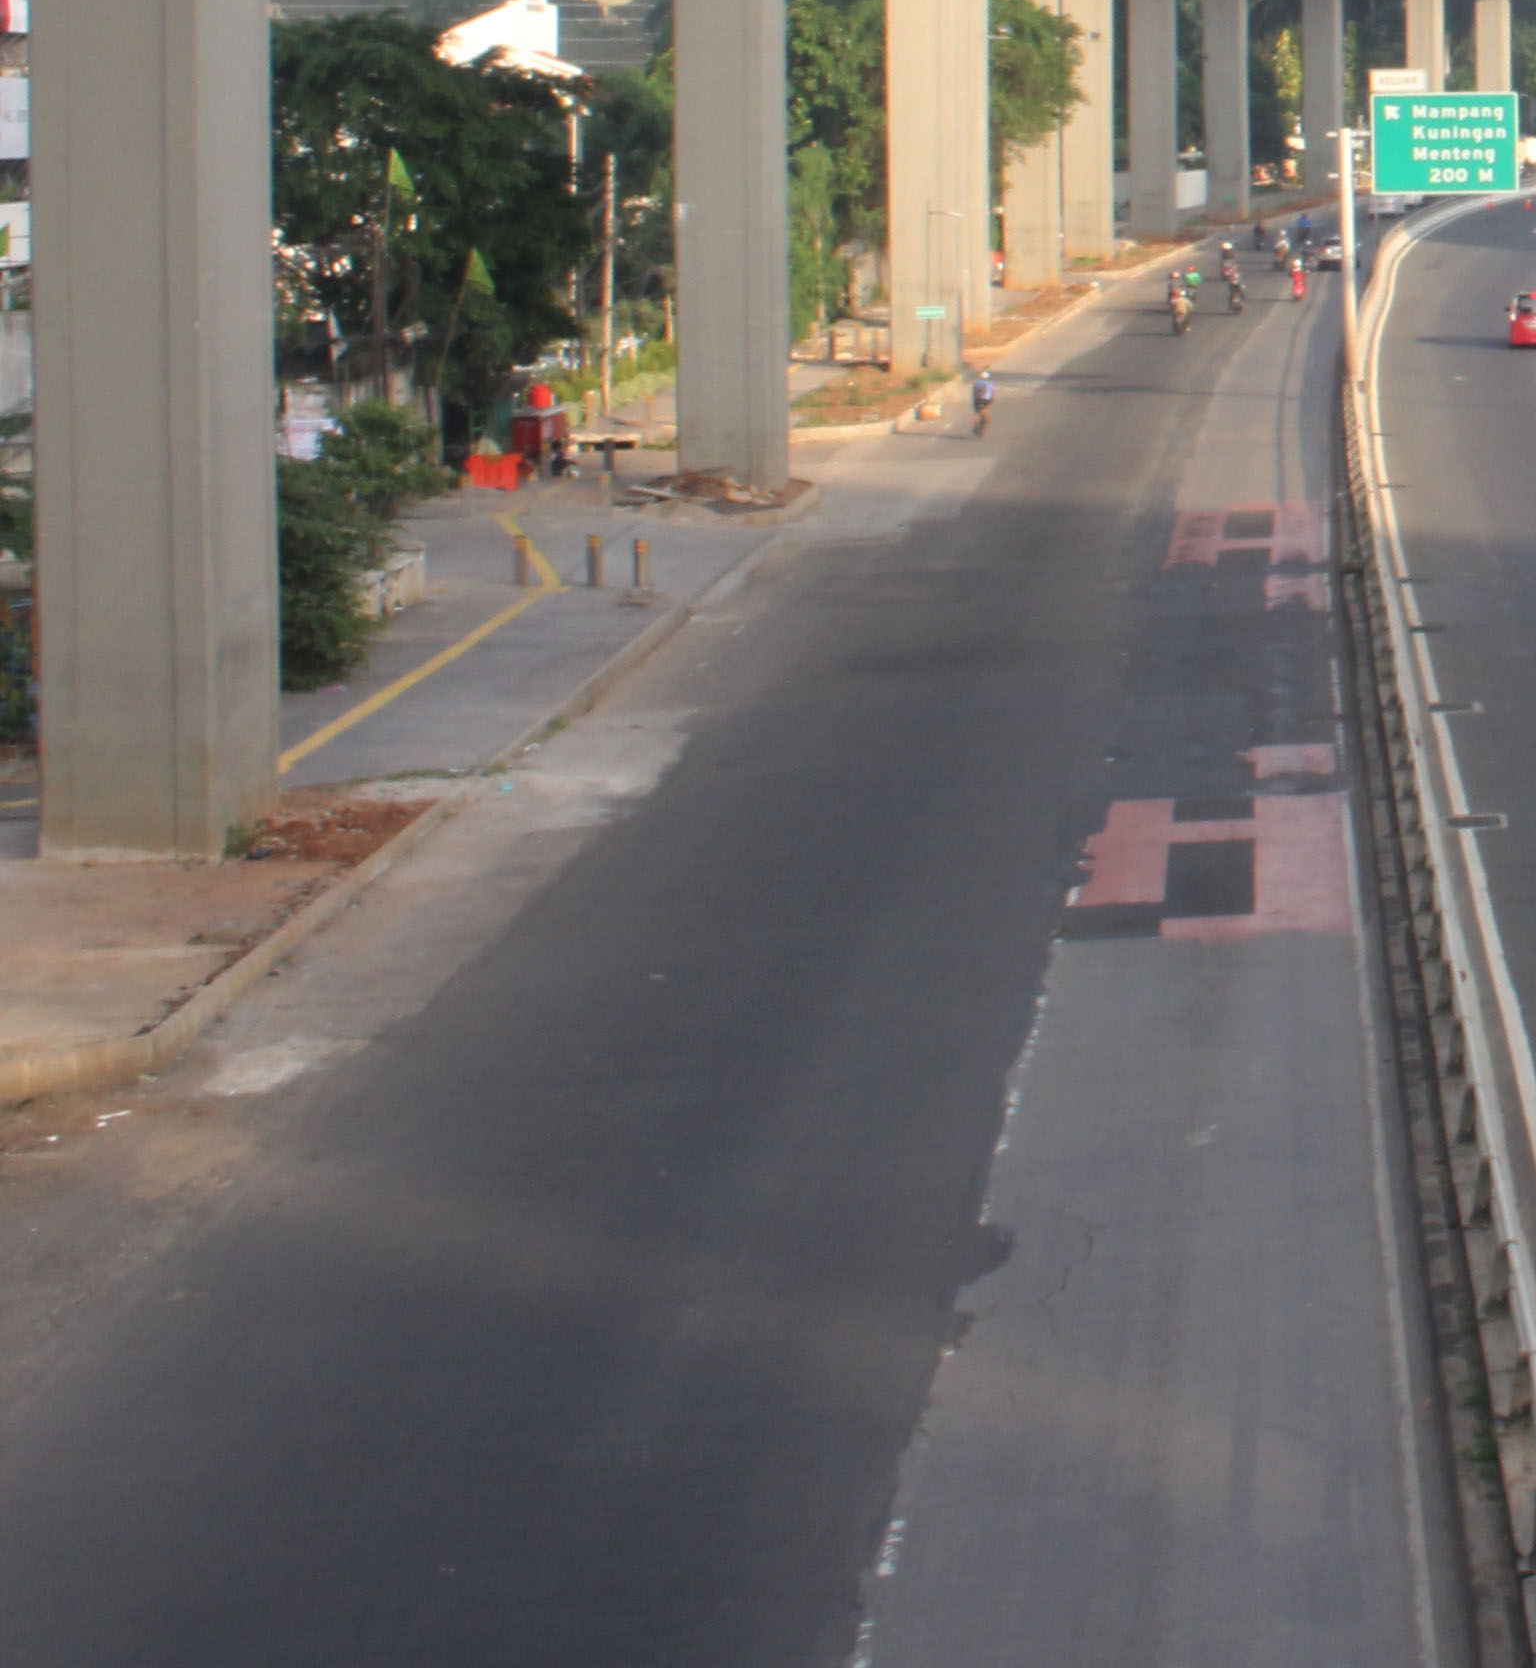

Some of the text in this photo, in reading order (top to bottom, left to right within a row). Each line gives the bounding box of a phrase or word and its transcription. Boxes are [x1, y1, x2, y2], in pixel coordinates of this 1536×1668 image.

[1411, 105, 1504, 122] Mampang
[1412, 125, 1507, 143] Kuningan
[1412, 147, 1496, 163] Menteng
[1428, 167, 1494, 183] 200 M
